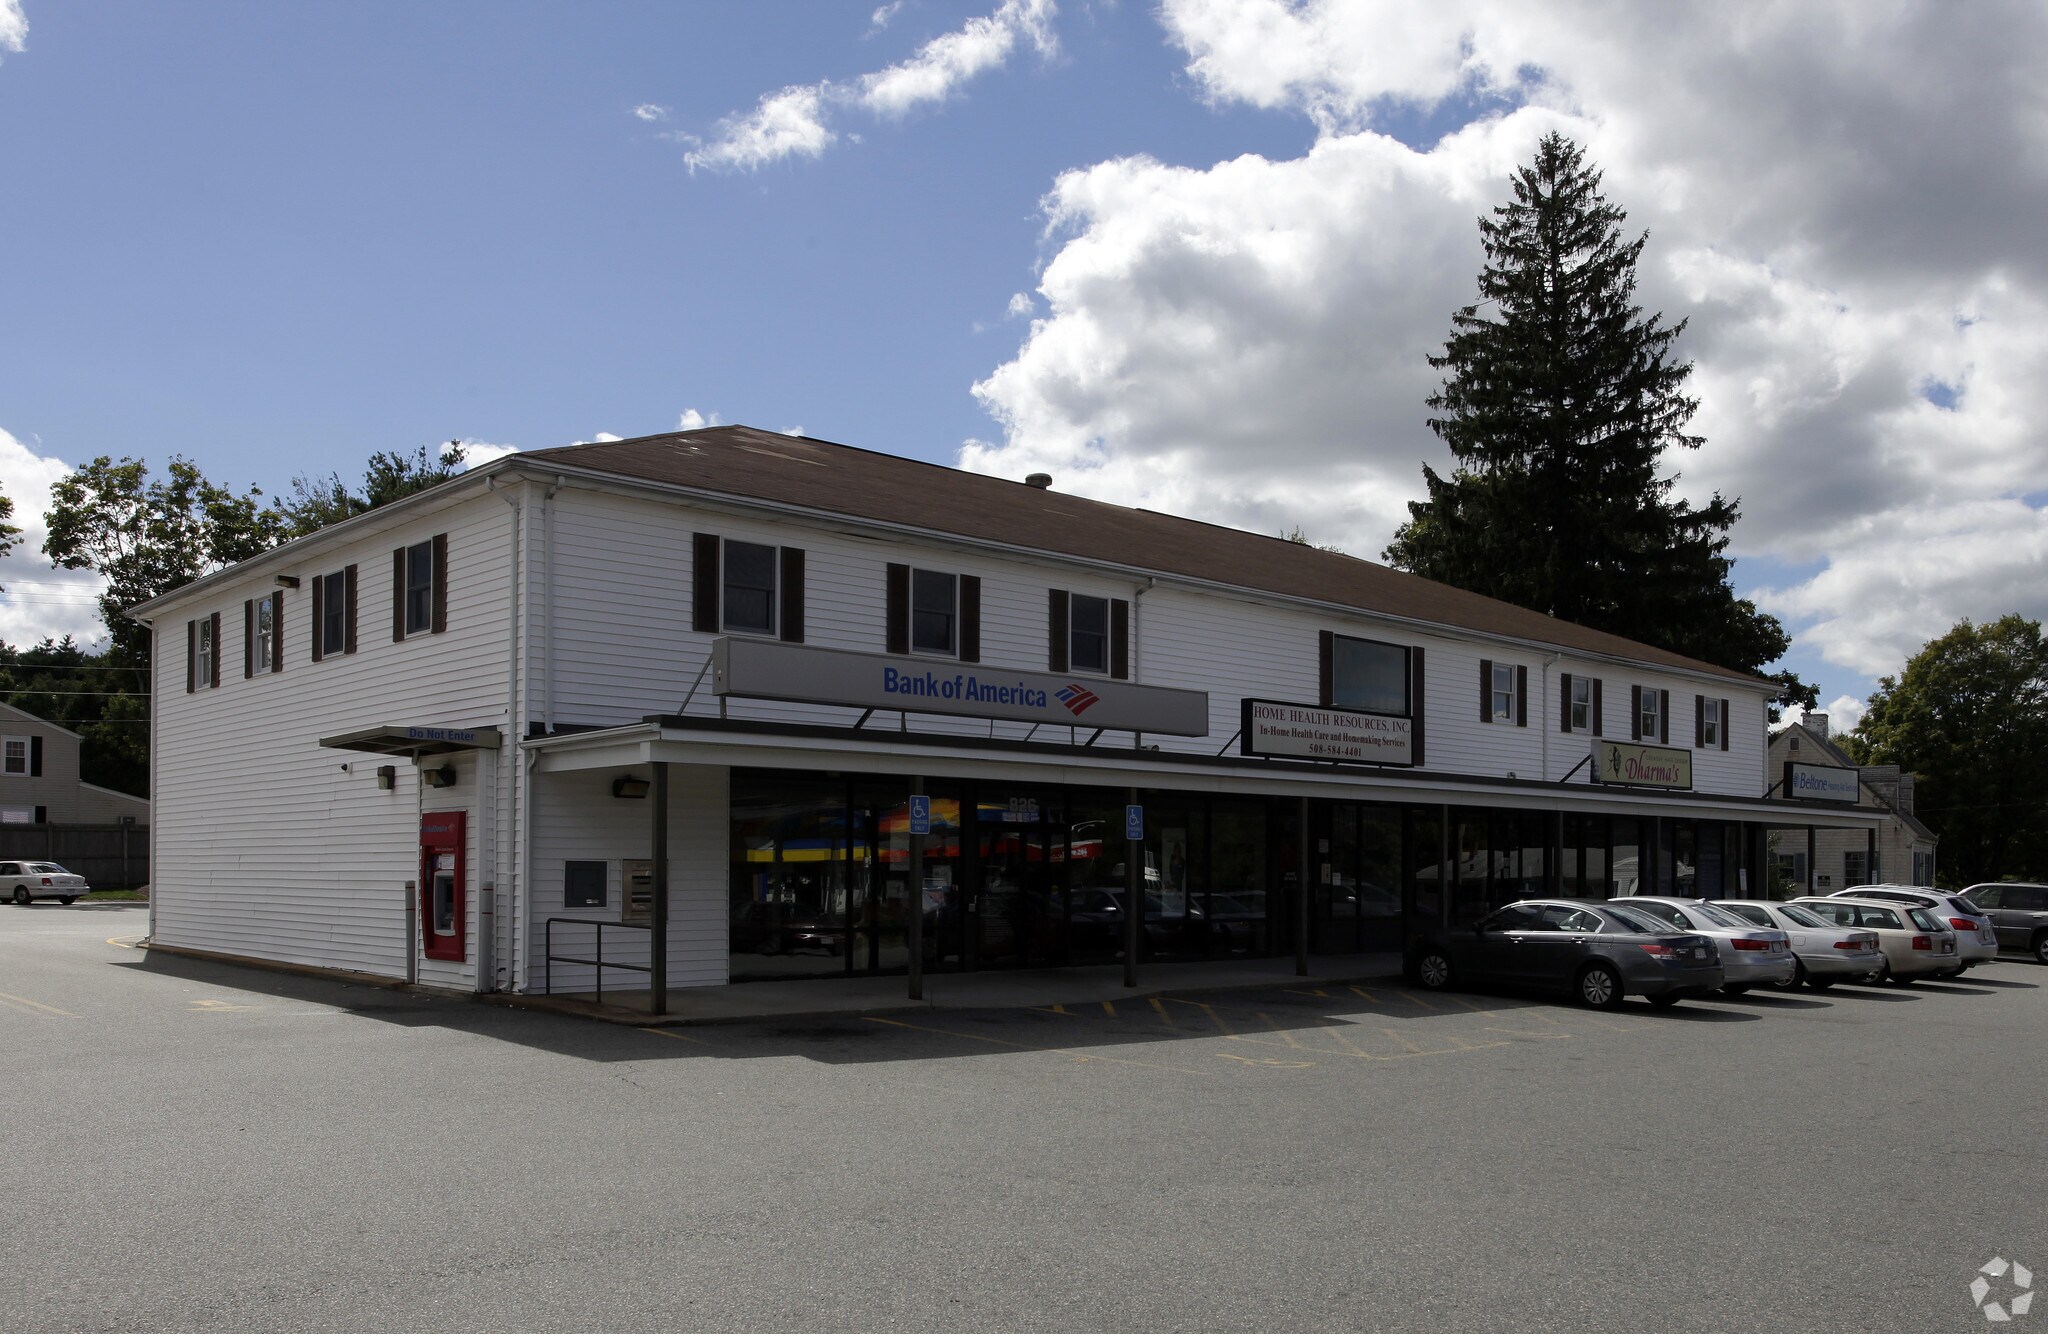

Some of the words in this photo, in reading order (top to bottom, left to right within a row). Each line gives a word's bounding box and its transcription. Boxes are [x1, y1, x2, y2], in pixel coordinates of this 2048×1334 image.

[884, 667, 939, 697] Bank
[941, 675, 963, 699] of
[965, 676, 1047, 708] America
[1254, 706, 1286, 721] HOME
[1290, 710, 1330, 726] HEALTH
[1333, 714, 1390, 733] RESOURCES,
[1392, 721, 1410, 733] INC.
[409, 728, 423, 738] Do
[427, 729, 445, 739] Not
[448, 730, 475, 741] Enter
[1260, 725, 1290, 737] In-Home
[1291, 728, 1313, 739] Health
[1314, 730, 1329, 741] Care
[1330, 732, 1341, 742] and
[1343, 732, 1381, 747] Homemaking
[1382, 736, 1405, 747] Services
[1309, 743, 1362, 757] 508-584-4401
[1625, 749, 1680, 783] Dharma's
[1800, 772, 1828, 792] Beltone
